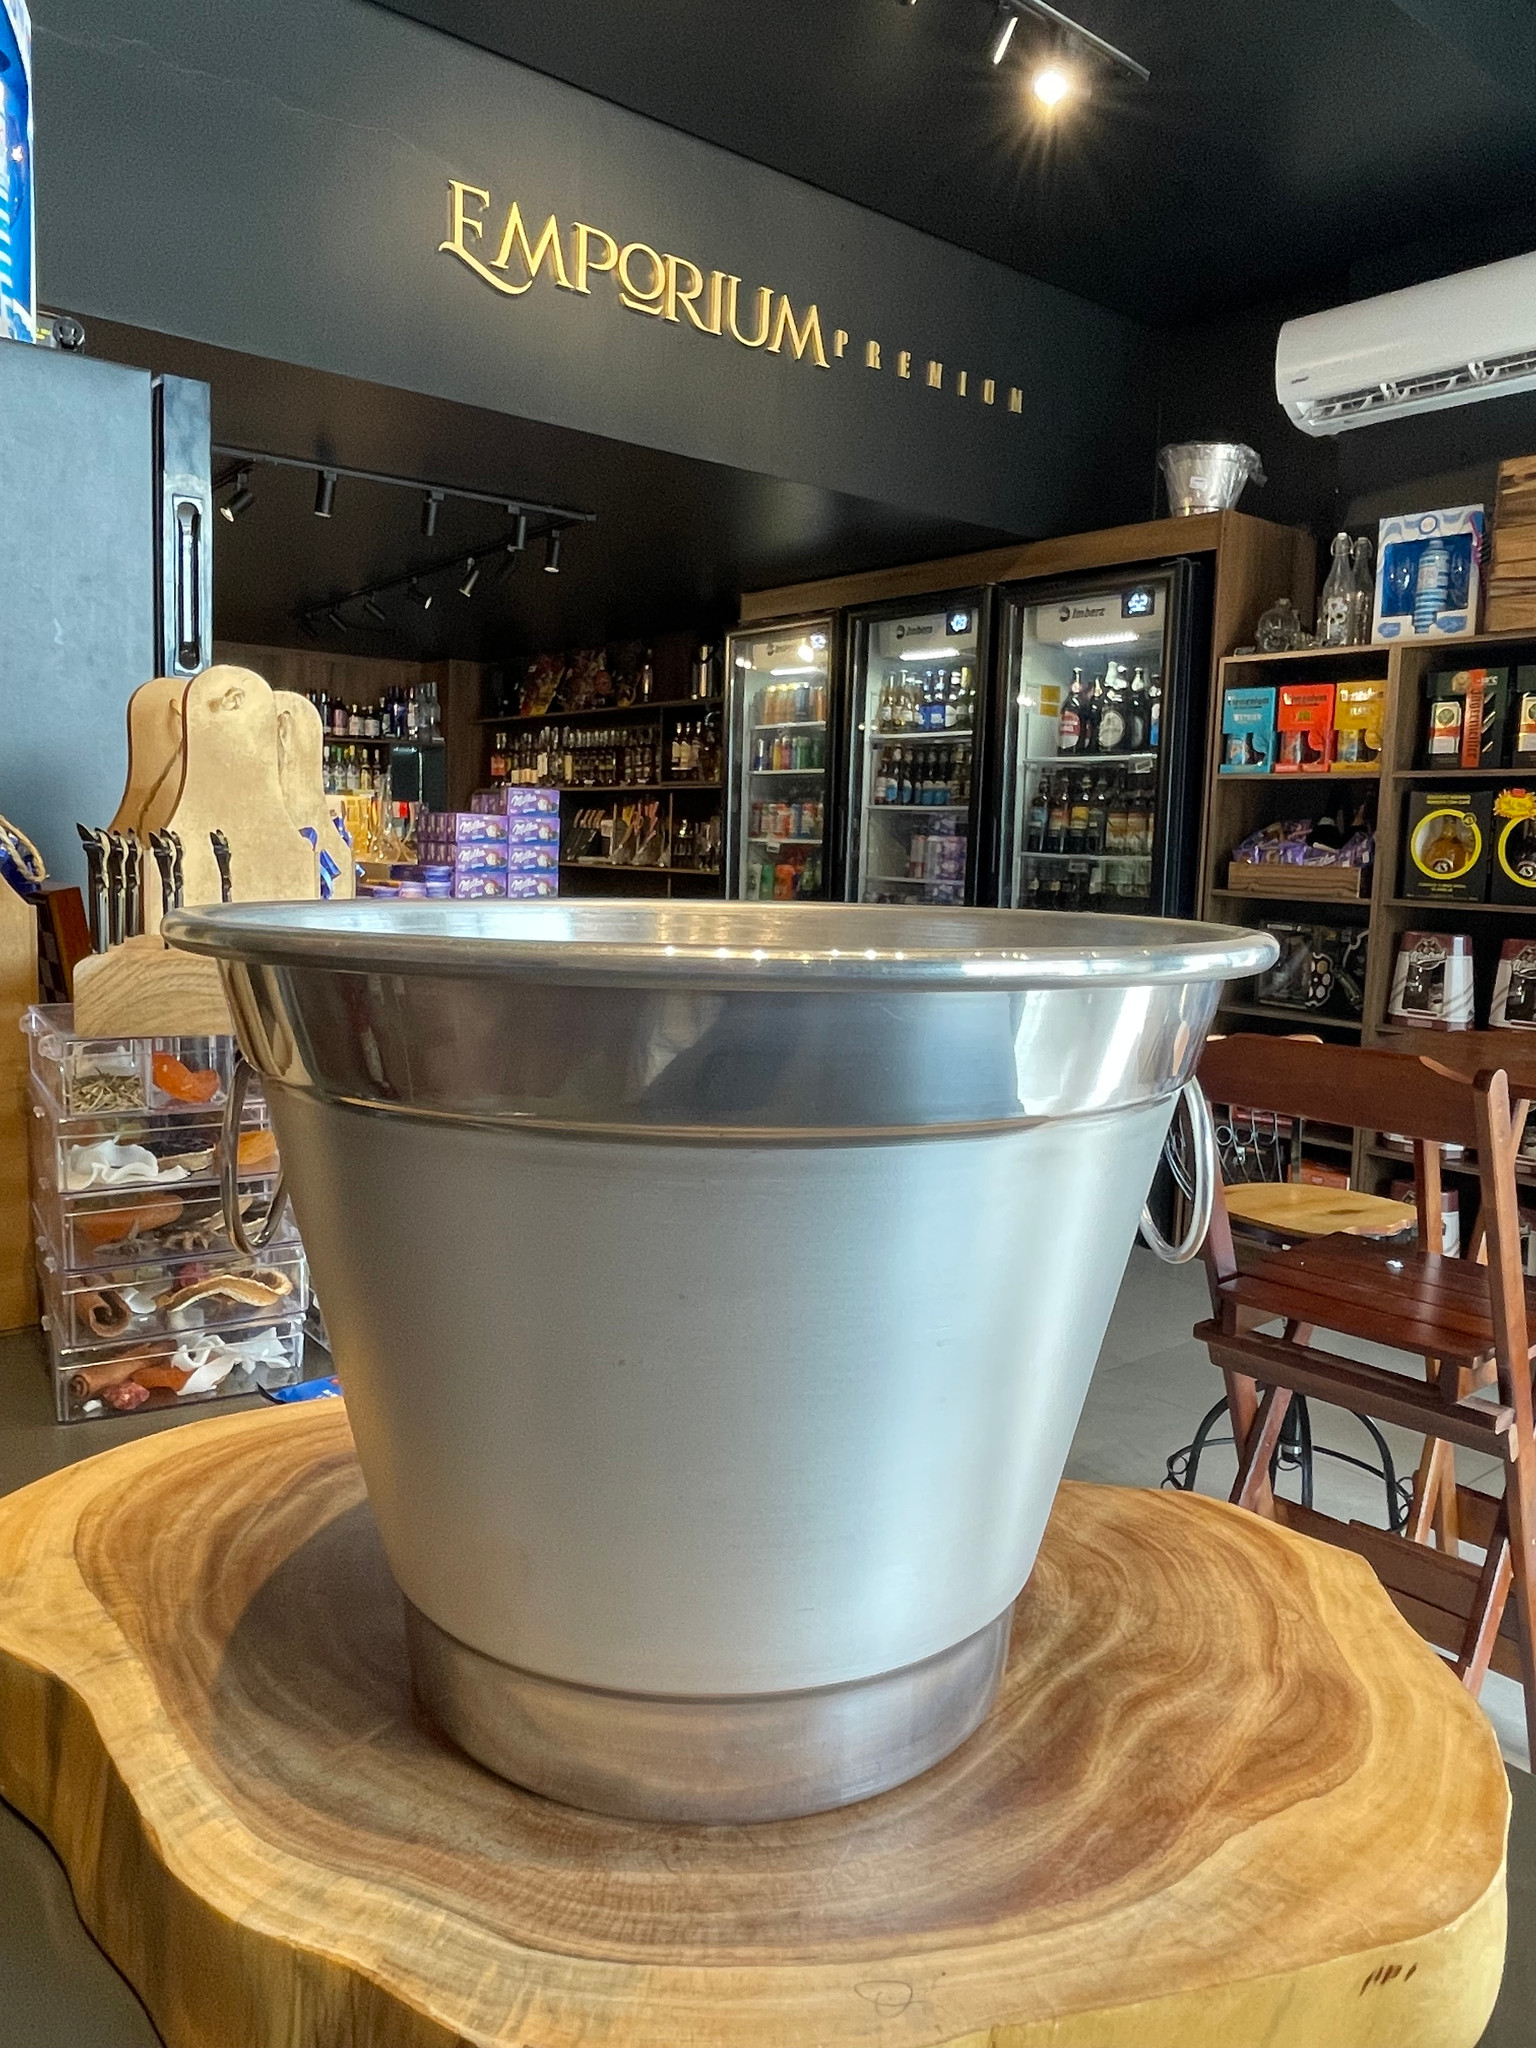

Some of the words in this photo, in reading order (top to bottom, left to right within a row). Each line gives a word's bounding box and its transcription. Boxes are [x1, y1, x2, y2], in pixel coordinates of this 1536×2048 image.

[438, 178, 831, 369] EMPORIUM
[834, 329, 1025, 415] PREMIUM
[459, 819, 487, 834] Milka
[458, 848, 487, 862] Milka
[458, 877, 485, 892] Milka
[511, 877, 538, 892] Milka
